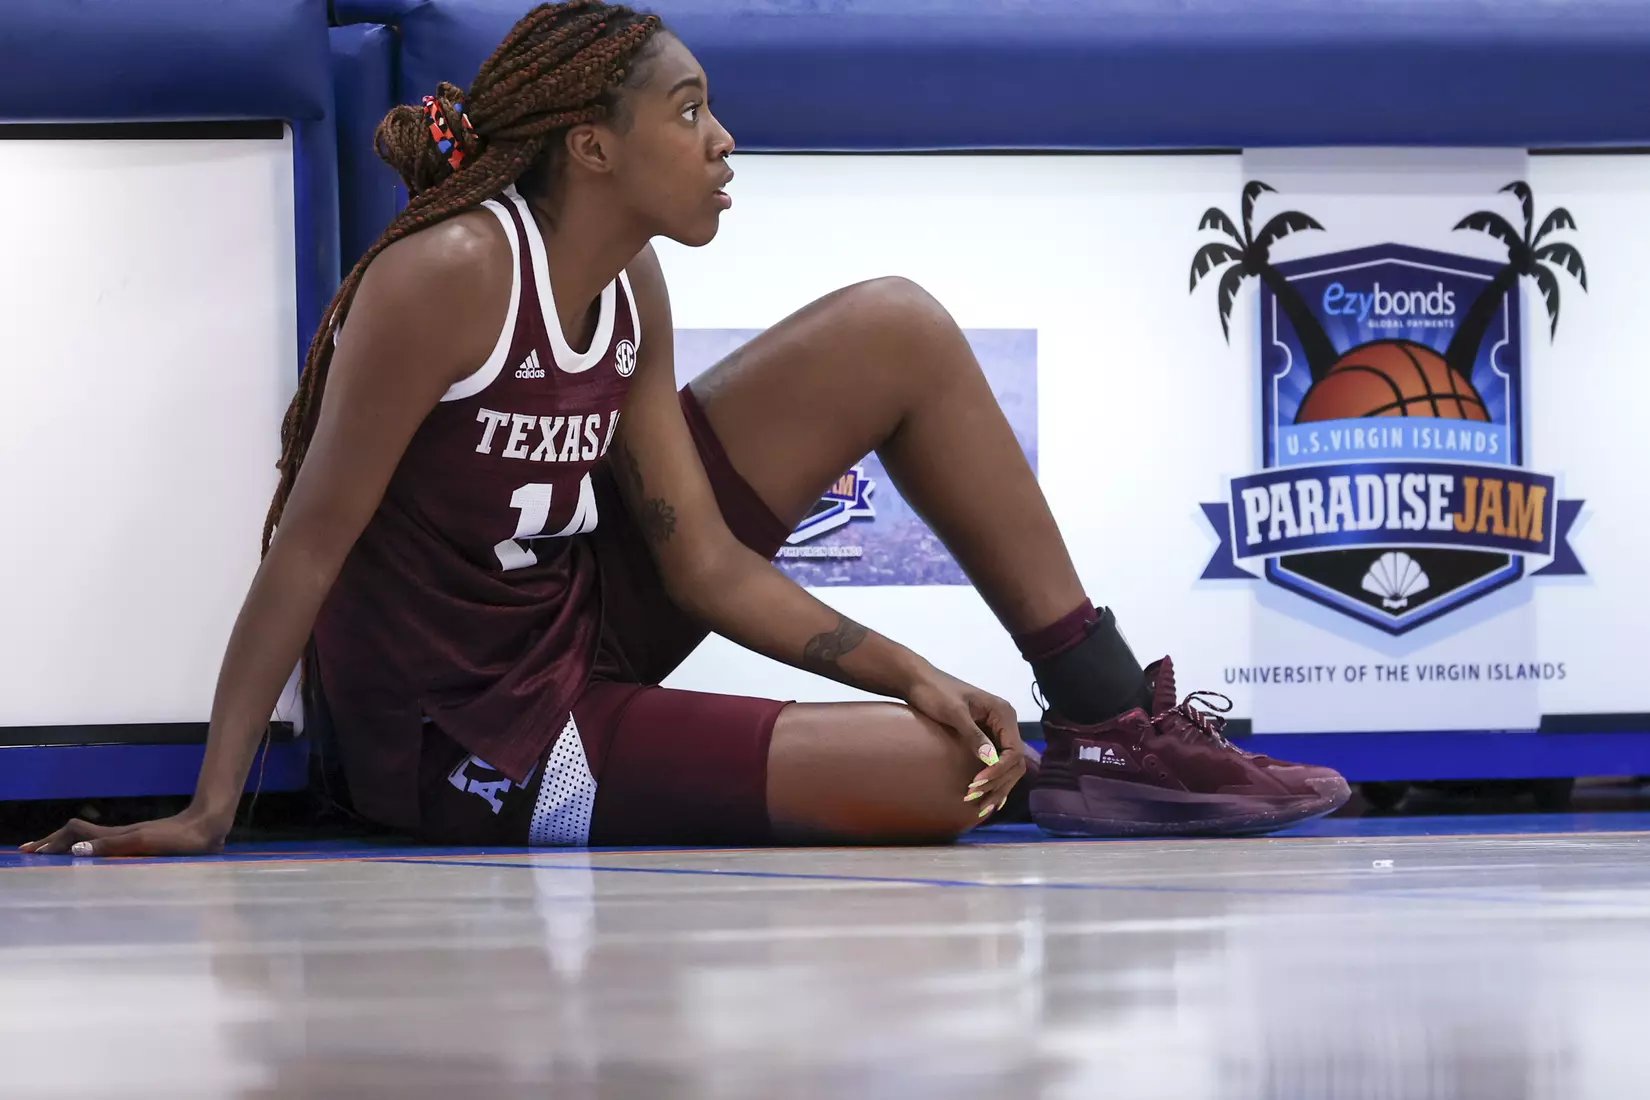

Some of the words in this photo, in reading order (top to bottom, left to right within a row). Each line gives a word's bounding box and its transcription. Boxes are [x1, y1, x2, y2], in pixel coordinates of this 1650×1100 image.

[1323, 282, 1456, 322] ezybonds
[615, 341, 635, 375] SEC
[515, 368, 545, 379] adidas
[475, 408, 601, 462] TEXAS
[1413, 427, 1499, 454] ISLANDS
[1224, 665, 1336, 684] UNIVERSITY
[1344, 665, 1367, 683] OF
[1375, 664, 1409, 682] THE
[1416, 663, 1480, 682] VIRGIN
[1488, 661, 1567, 681] ISLANDS
